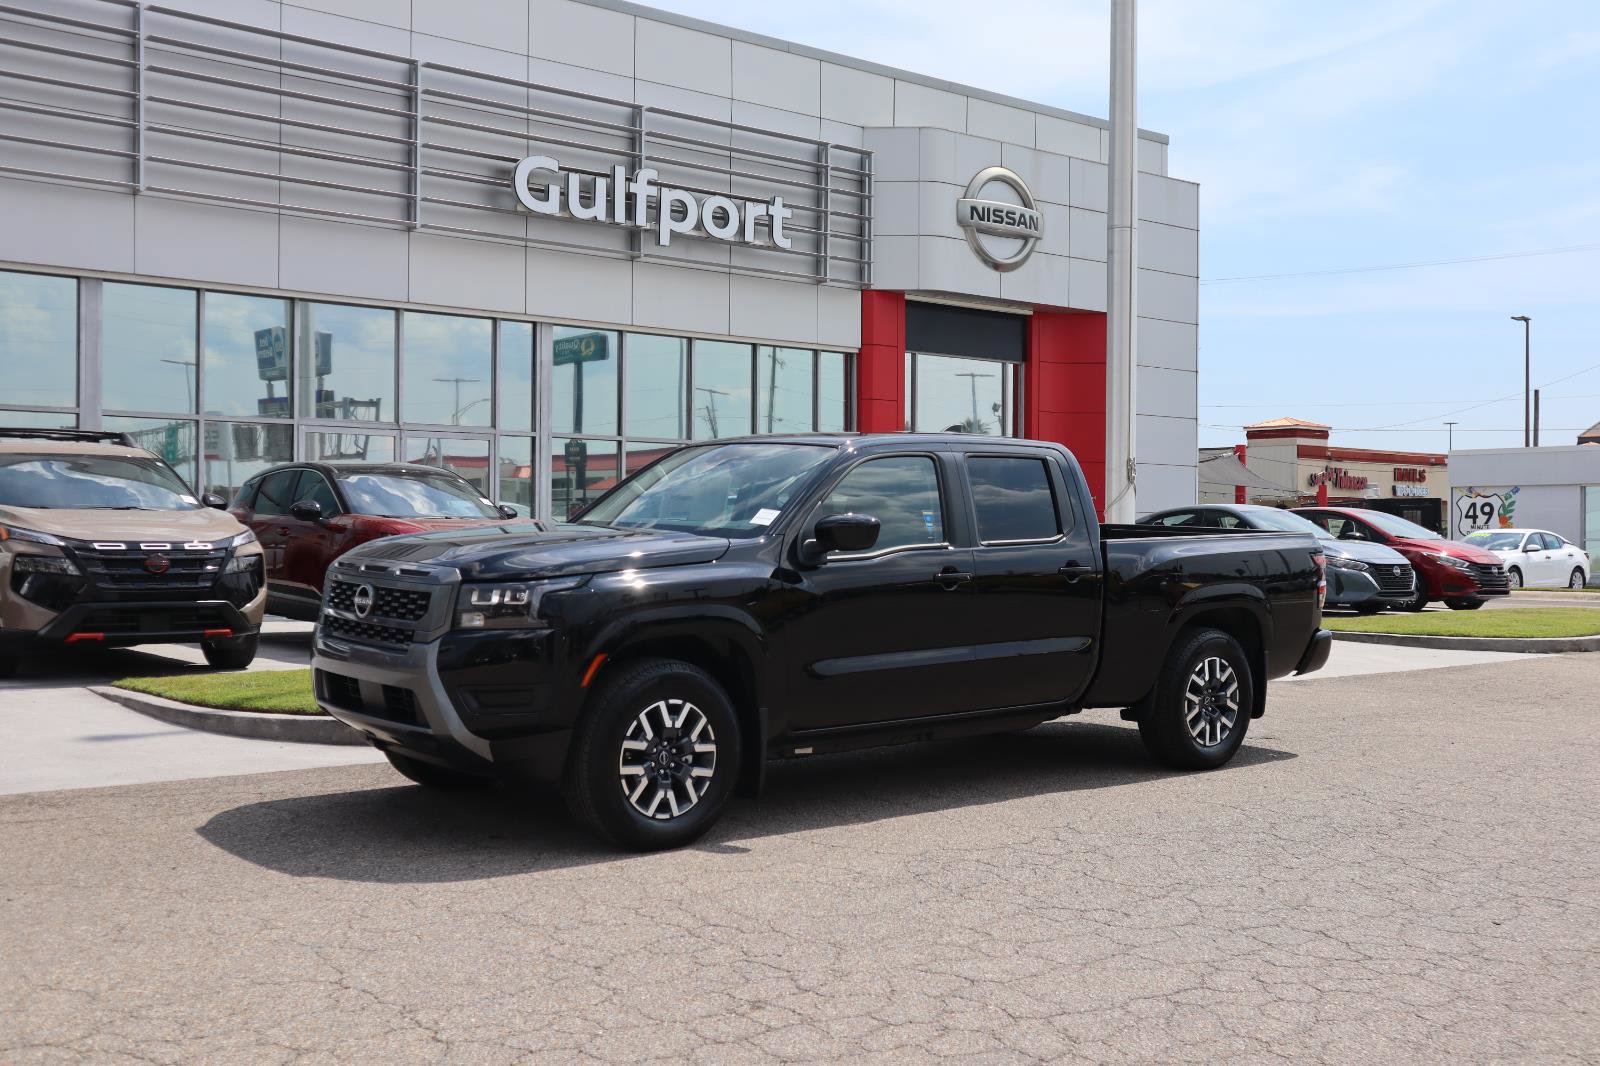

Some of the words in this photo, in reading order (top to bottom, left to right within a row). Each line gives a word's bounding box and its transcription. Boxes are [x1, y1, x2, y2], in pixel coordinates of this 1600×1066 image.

[513, 155, 792, 248] Gulfport
[970, 205, 1039, 232] NISSAN
[1394, 467, 1427, 483] NAILS
[1464, 502, 1494, 525] 49
